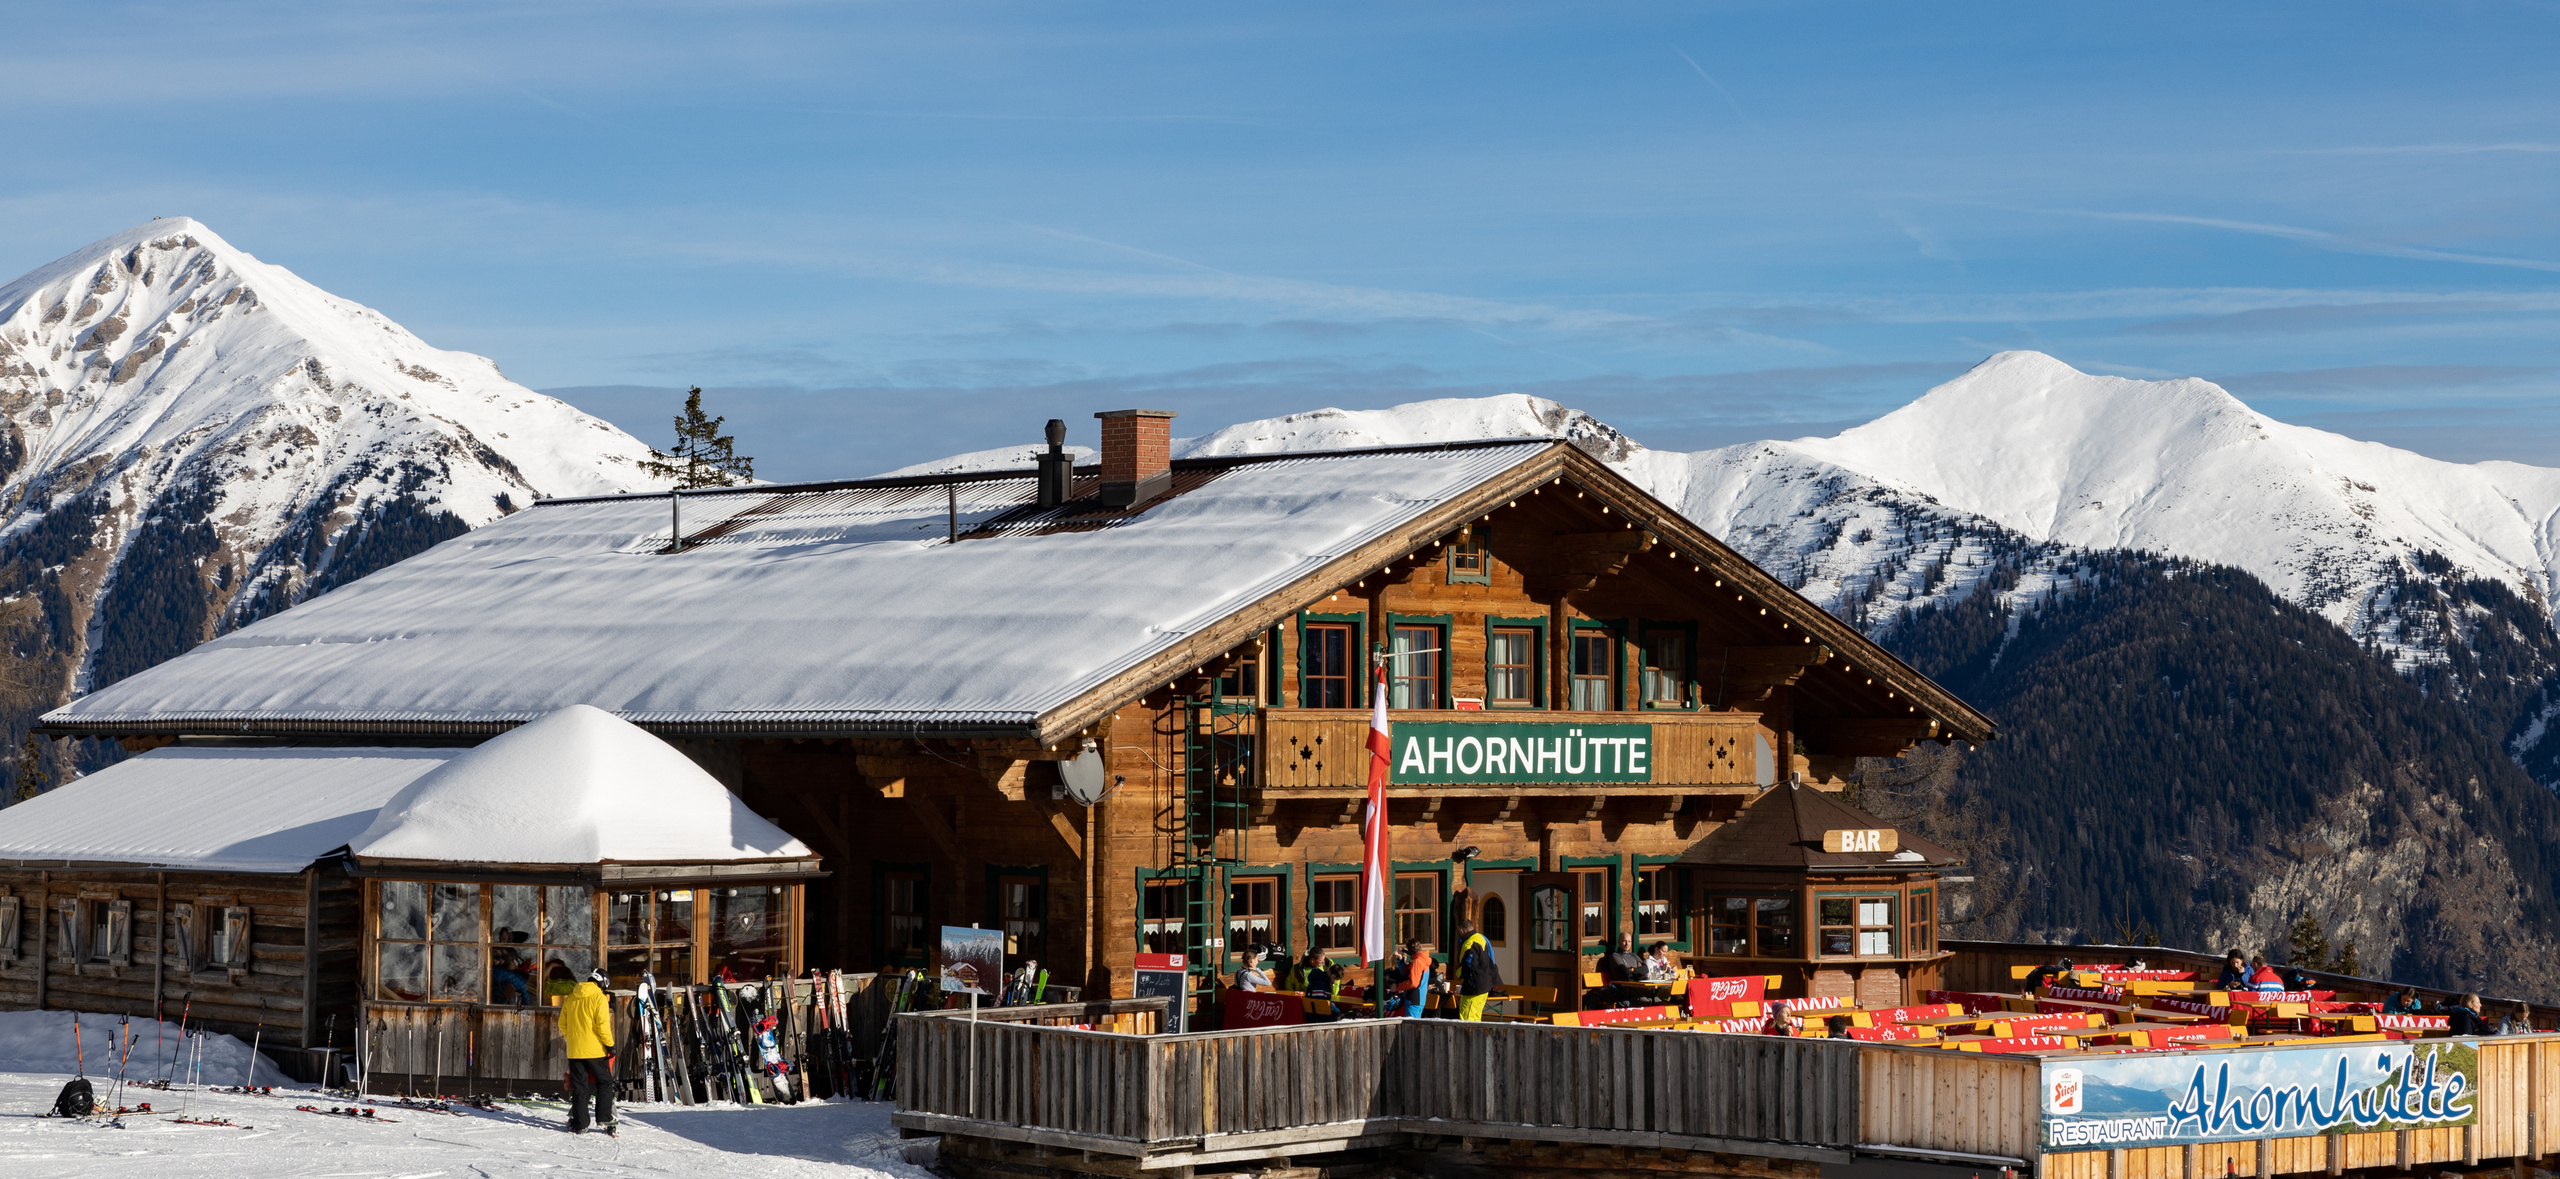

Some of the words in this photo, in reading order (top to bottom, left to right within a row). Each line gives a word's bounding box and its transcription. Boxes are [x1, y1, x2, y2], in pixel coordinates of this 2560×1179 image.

[1399, 729, 1647, 774] AHORNHÜTTE
[1841, 830, 1881, 852] BAR
[2051, 1119, 2166, 1143] RESTAURANT
[2168, 1050, 2473, 1137] Ahornhütte
[2054, 1081, 2077, 1103] Stiegl
